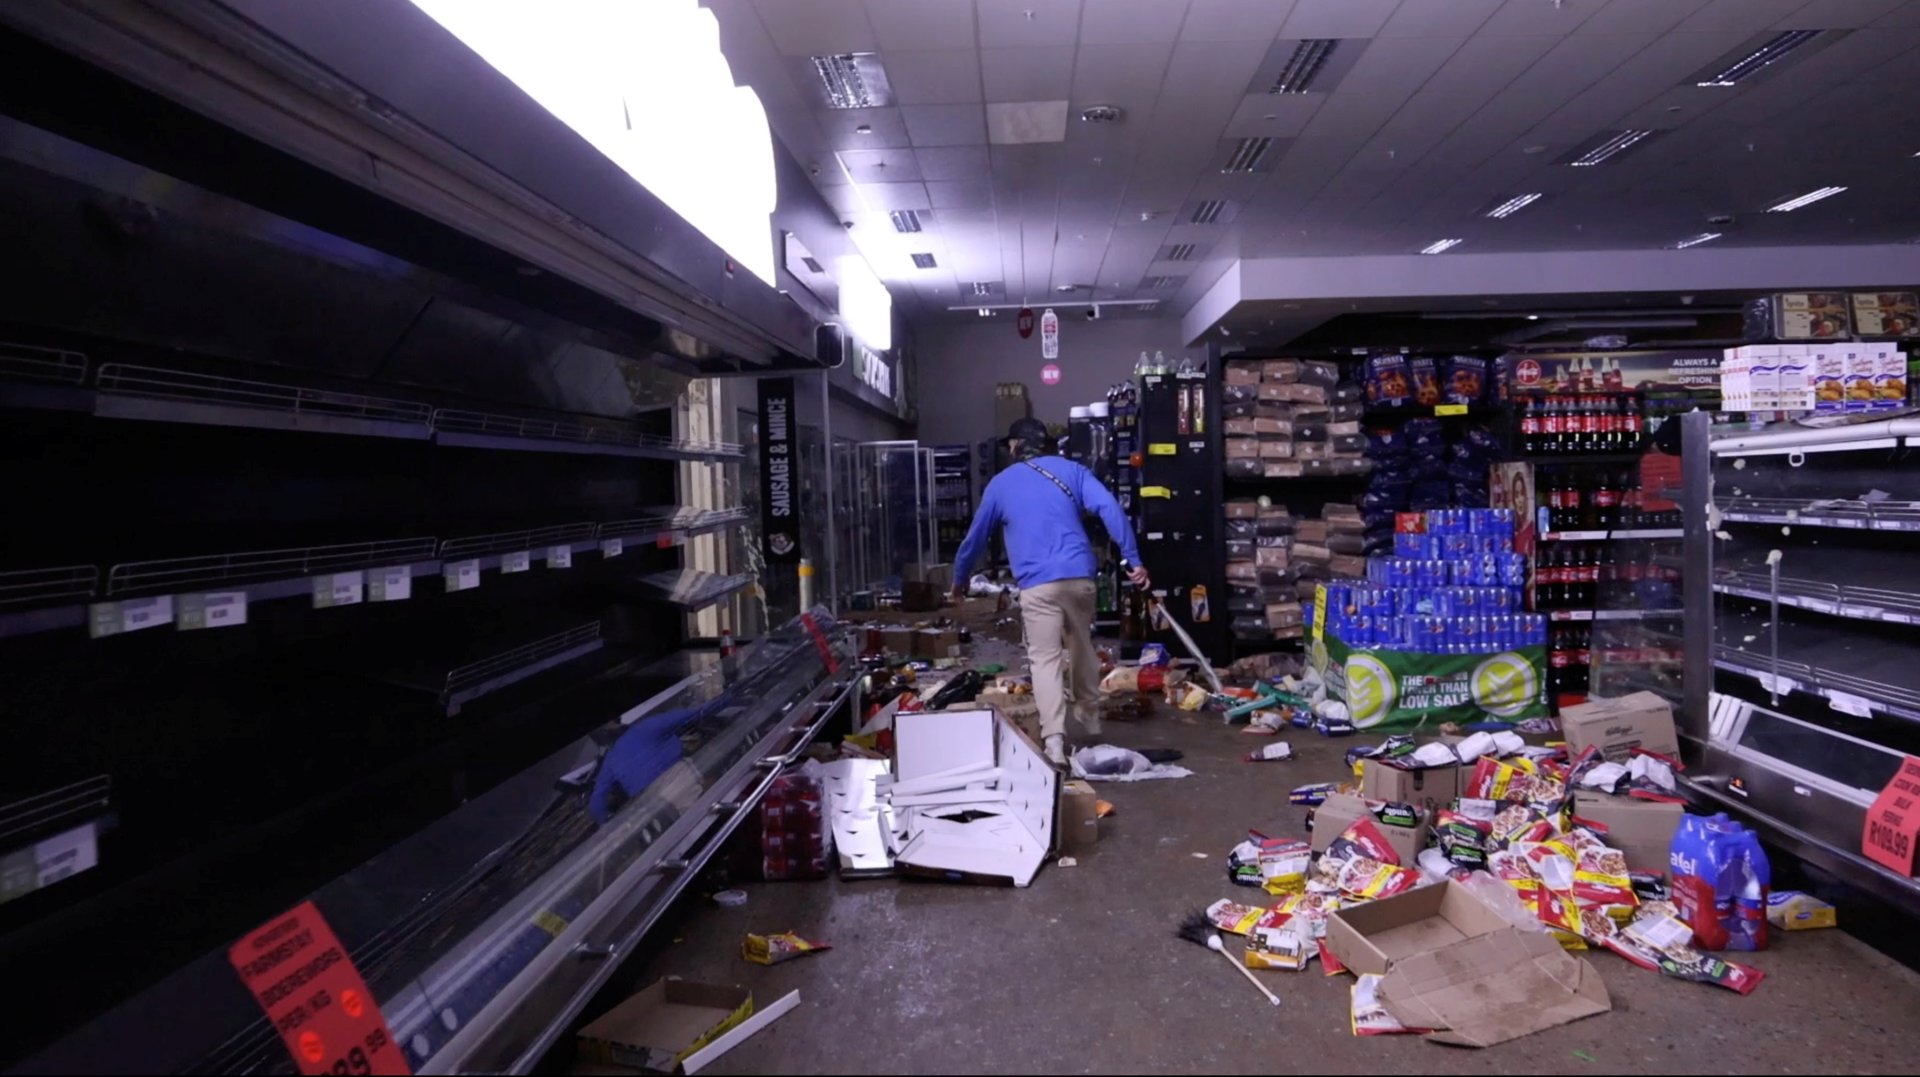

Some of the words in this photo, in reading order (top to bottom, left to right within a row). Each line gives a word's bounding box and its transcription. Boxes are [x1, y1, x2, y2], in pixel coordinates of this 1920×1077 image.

[1672, 358, 1708, 367] ALWAYS
[1710, 358, 1718, 366] A
[1678, 376, 1713, 385] OPTION
[767, 397, 787, 441] MINCE
[769, 443, 788, 456] &
[769, 456, 791, 517] SAUSAGE
[1402, 674, 1423, 686] THE
[1439, 681, 1469, 694] THAN
[1398, 694, 1430, 710] LOW
[1433, 693, 1470, 708] SALE
